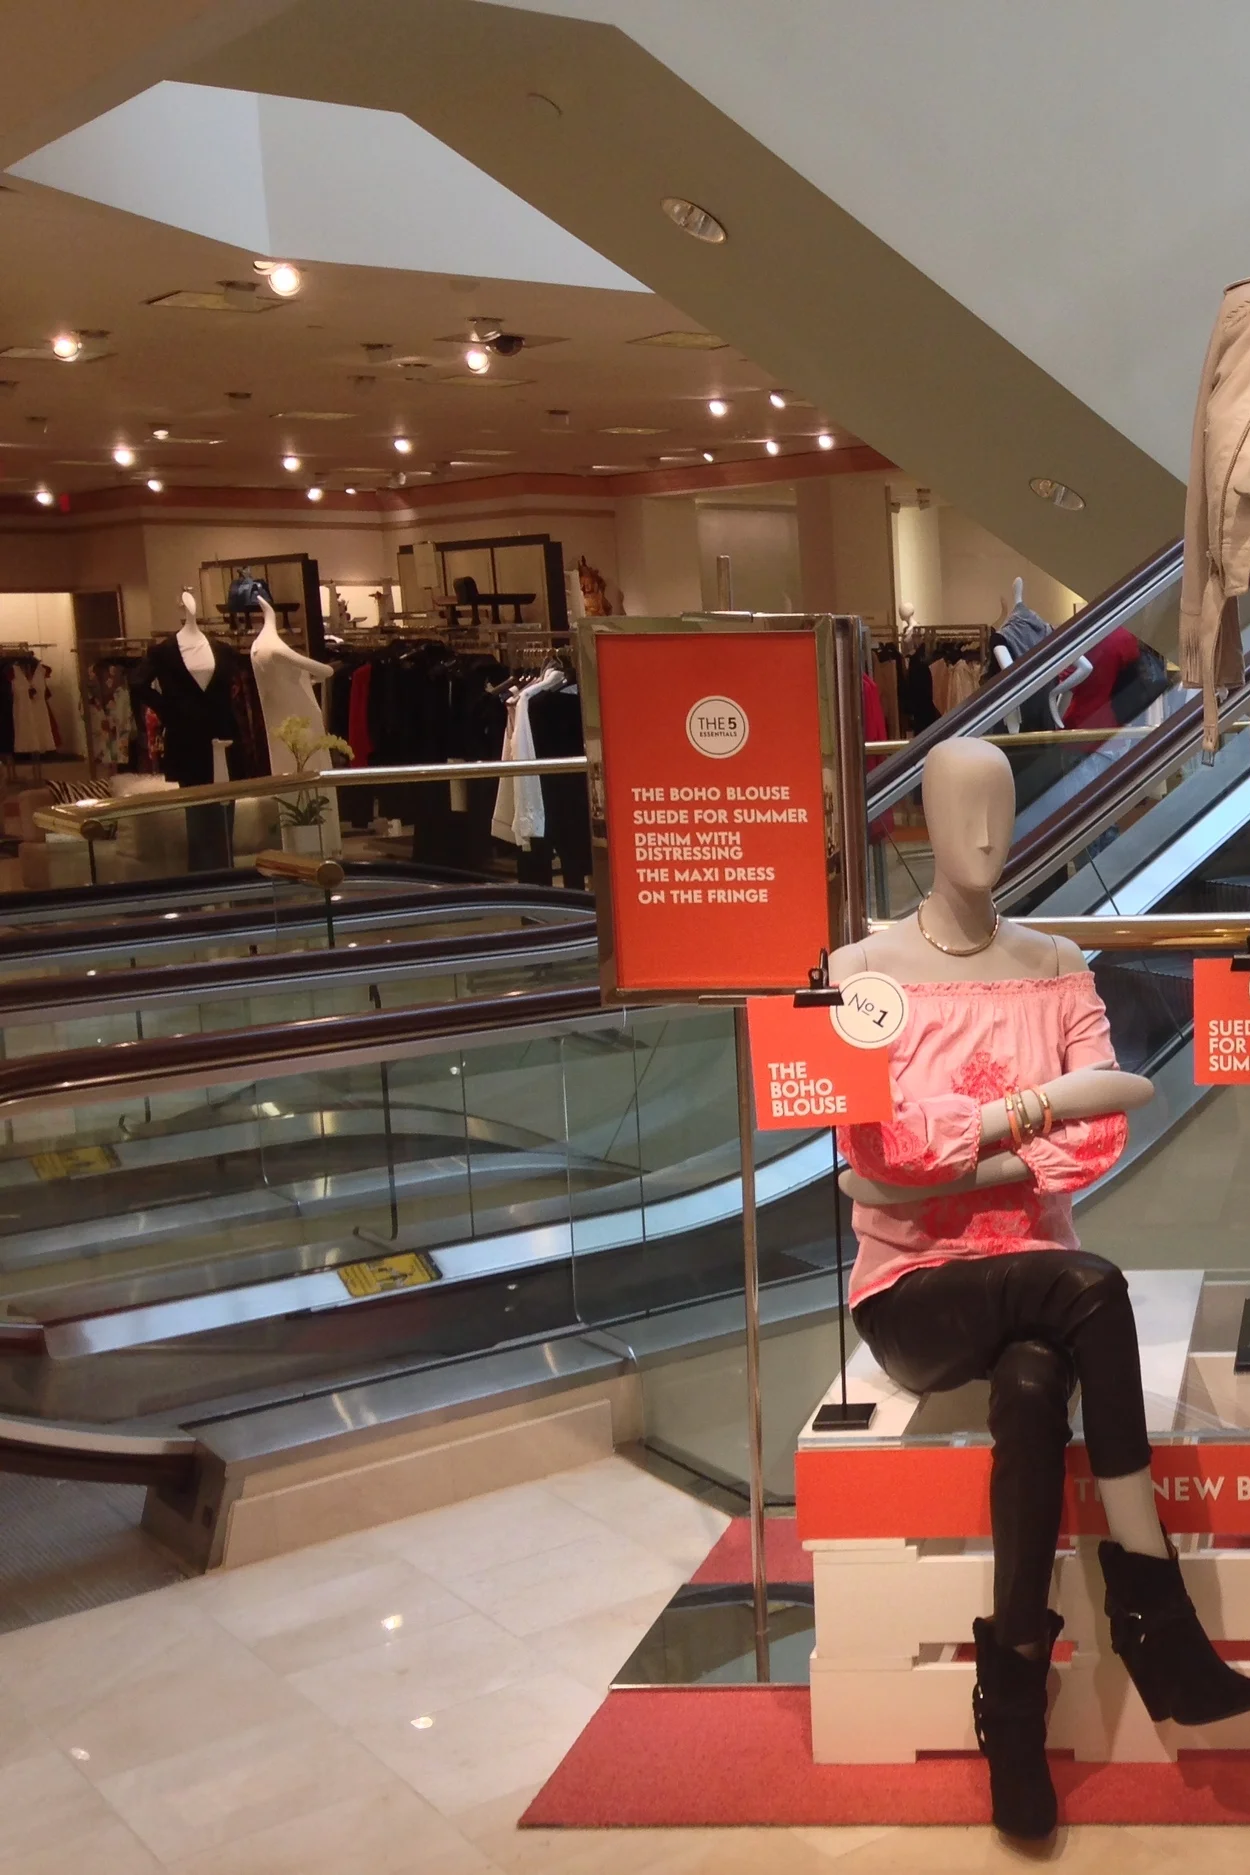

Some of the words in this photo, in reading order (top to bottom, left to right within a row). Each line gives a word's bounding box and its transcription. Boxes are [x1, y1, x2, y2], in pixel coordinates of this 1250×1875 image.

[698, 717, 725, 730] THE
[728, 717, 737, 730] 5
[632, 788, 665, 801] THE
[670, 787, 721, 801] BOHO
[726, 786, 790, 801] BLOUSE
[633, 810, 689, 825] SUEDE
[694, 809, 728, 823] FOR
[733, 808, 808, 823] SUMMER
[635, 832, 691, 847] DENIM
[696, 831, 741, 846] WITH
[636, 846, 743, 861] DISTRESSING
[637, 869, 669, 882] THE
[674, 868, 719, 882] MAXI
[725, 867, 775, 882] DRESS
[638, 890, 665, 904] ON
[670, 889, 702, 903] THE
[707, 889, 768, 903] FRINGE
[872, 1009, 889, 1028] 1
[1209, 1037, 1246, 1054] FOR
[768, 1062, 807, 1080] THE
[770, 1078, 833, 1099] BOHO
[772, 1096, 847, 1117] BLOUSE
[1152, 1476, 1224, 1501] NEW
